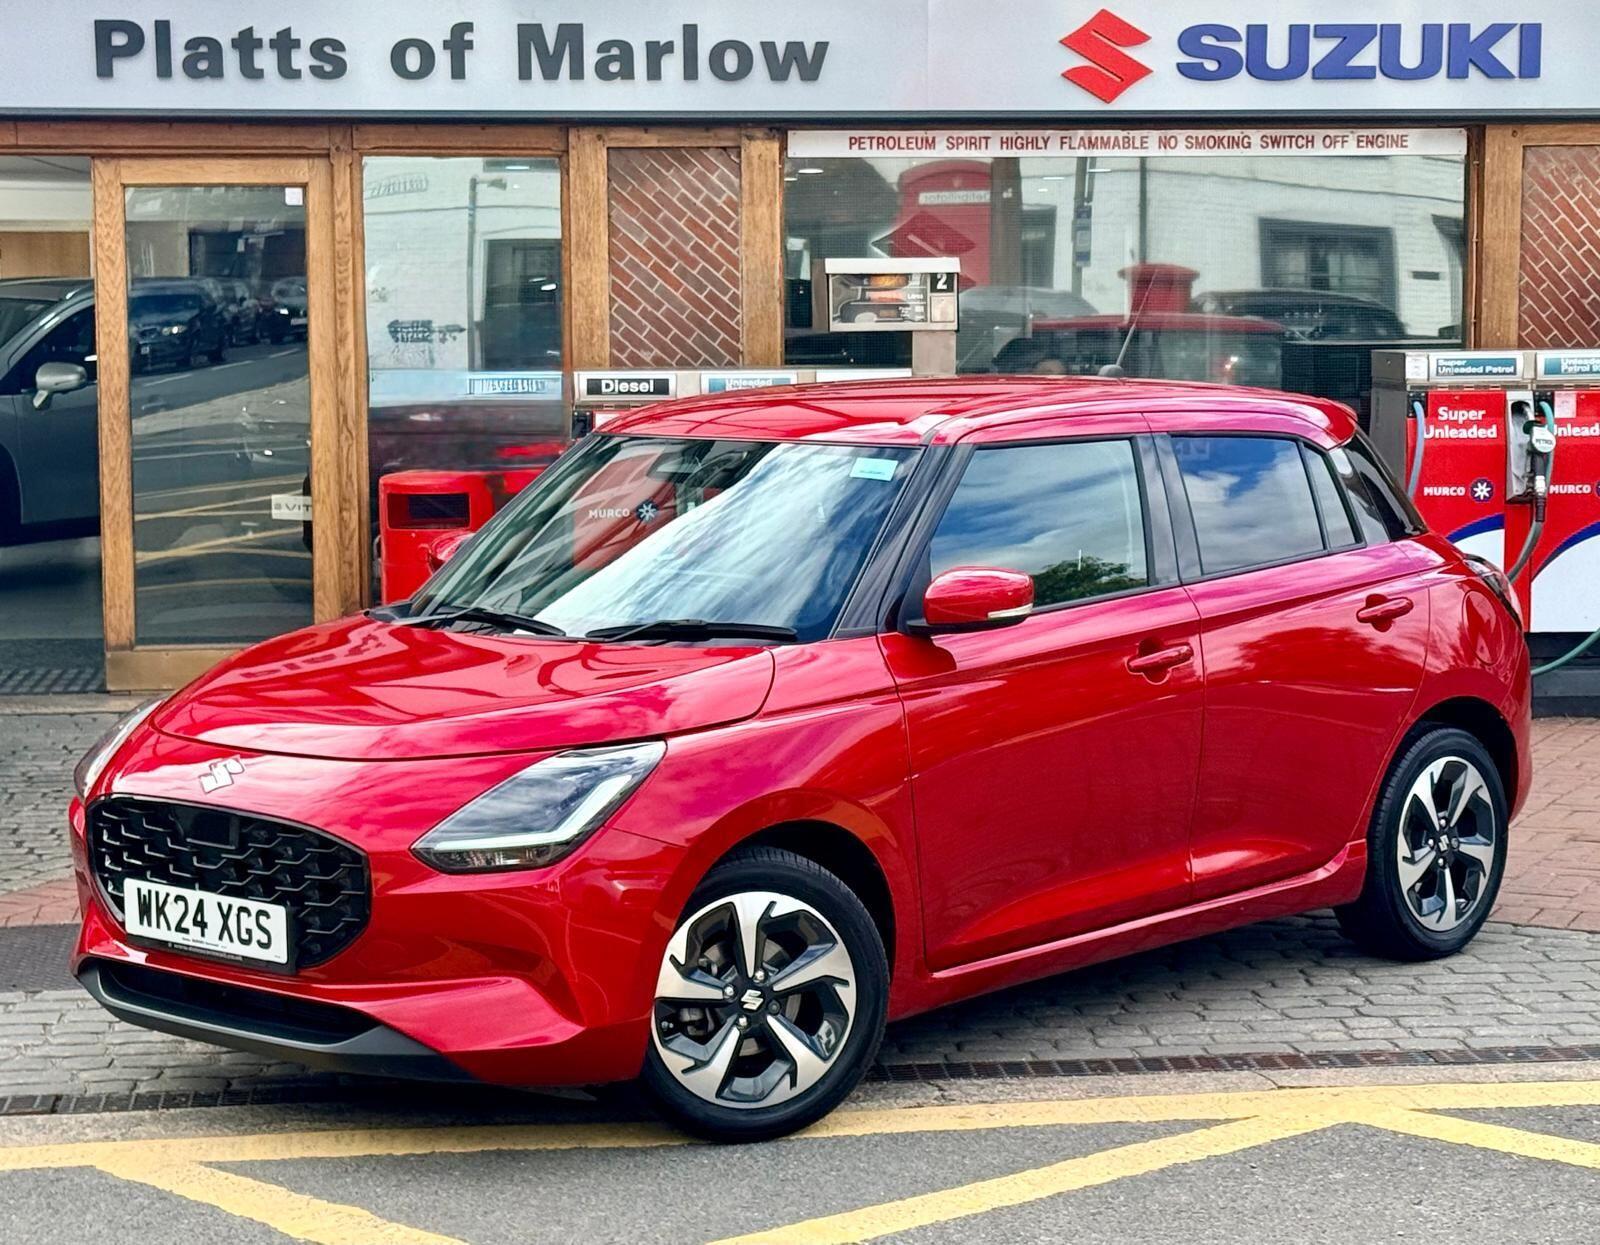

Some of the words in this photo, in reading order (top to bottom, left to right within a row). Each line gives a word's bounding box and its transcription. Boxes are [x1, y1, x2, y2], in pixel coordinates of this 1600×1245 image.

[94, 19, 348, 80] Platts
[390, 22, 474, 81] of
[517, 23, 830, 82] Marlow
[1176, 23, 1542, 81] SUZUKI
[848, 135, 936, 151] PETROLEUM
[946, 135, 992, 150] SPIRIT
[999, 135, 1051, 150] HIGHLY
[1060, 135, 1149, 150] FLAMMABLE
[1157, 135, 1178, 150] NO
[1184, 134, 1252, 150] SMOKING
[1260, 134, 1315, 149] SWITCH
[1322, 134, 1349, 149] OFF
[1356, 134, 1409, 149] ENGINE
[936, 273, 948, 290] 2
[1438, 366, 1483, 374] Unleaded
[1485, 366, 1514, 374] Petrol
[601, 379, 654, 393] Diesel
[1438, 406, 1486, 424] Super
[1423, 424, 1497, 438] Unleaded
[1423, 486, 1466, 496] MURCO
[1549, 484, 1592, 494] MURCO
[588, 508, 630, 518] MURCO
[136, 887, 209, 938] WK24
[216, 900, 273, 950] XGS
